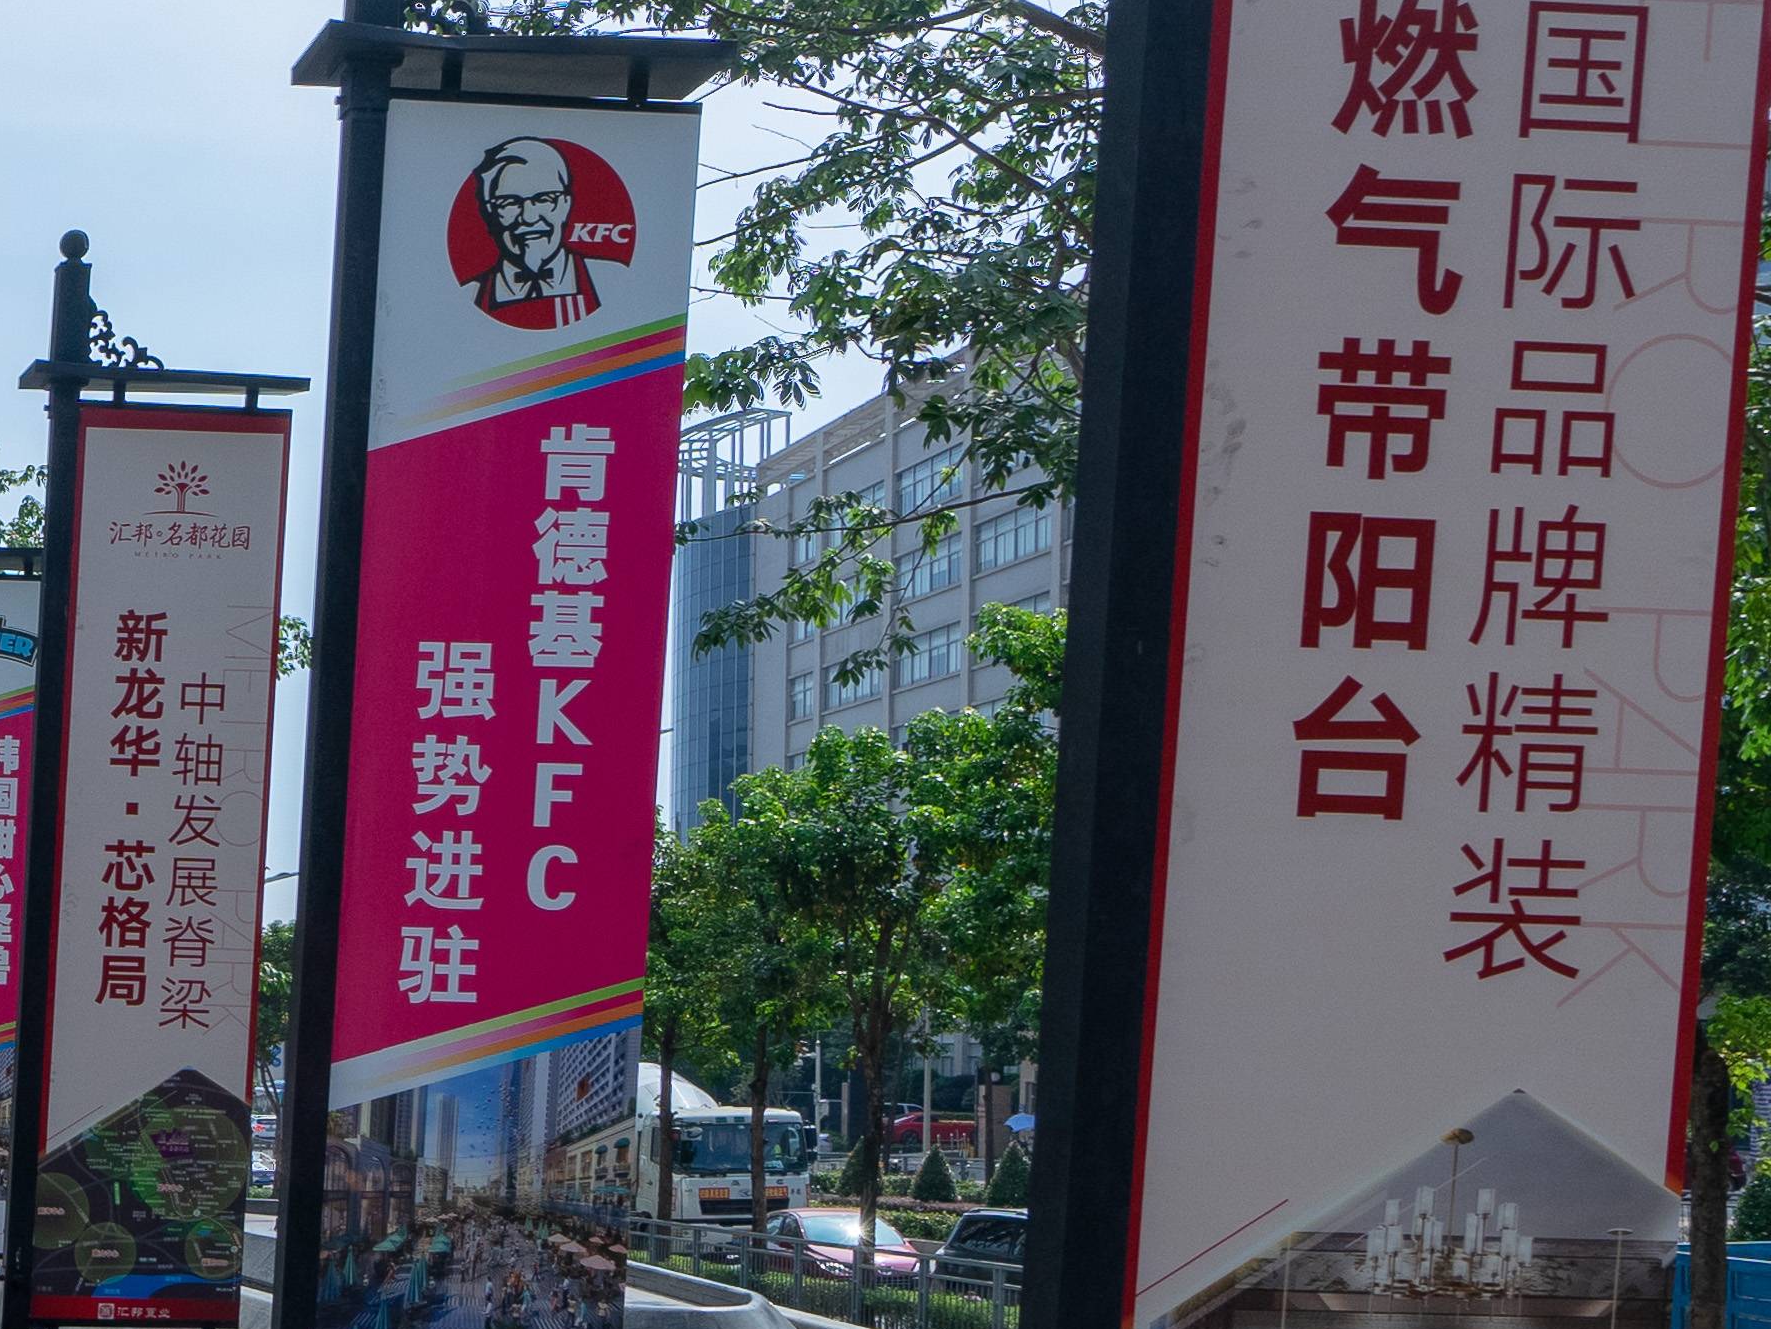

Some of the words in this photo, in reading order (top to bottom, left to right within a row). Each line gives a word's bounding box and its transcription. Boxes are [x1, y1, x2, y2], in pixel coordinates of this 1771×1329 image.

[569, 220, 636, 247] KFC
[398, 640, 495, 1005] 强势进驻
[526, 423, 614, 912] 肯德基KFC
[158, 671, 226, 1031] 中轴发展脊梁
